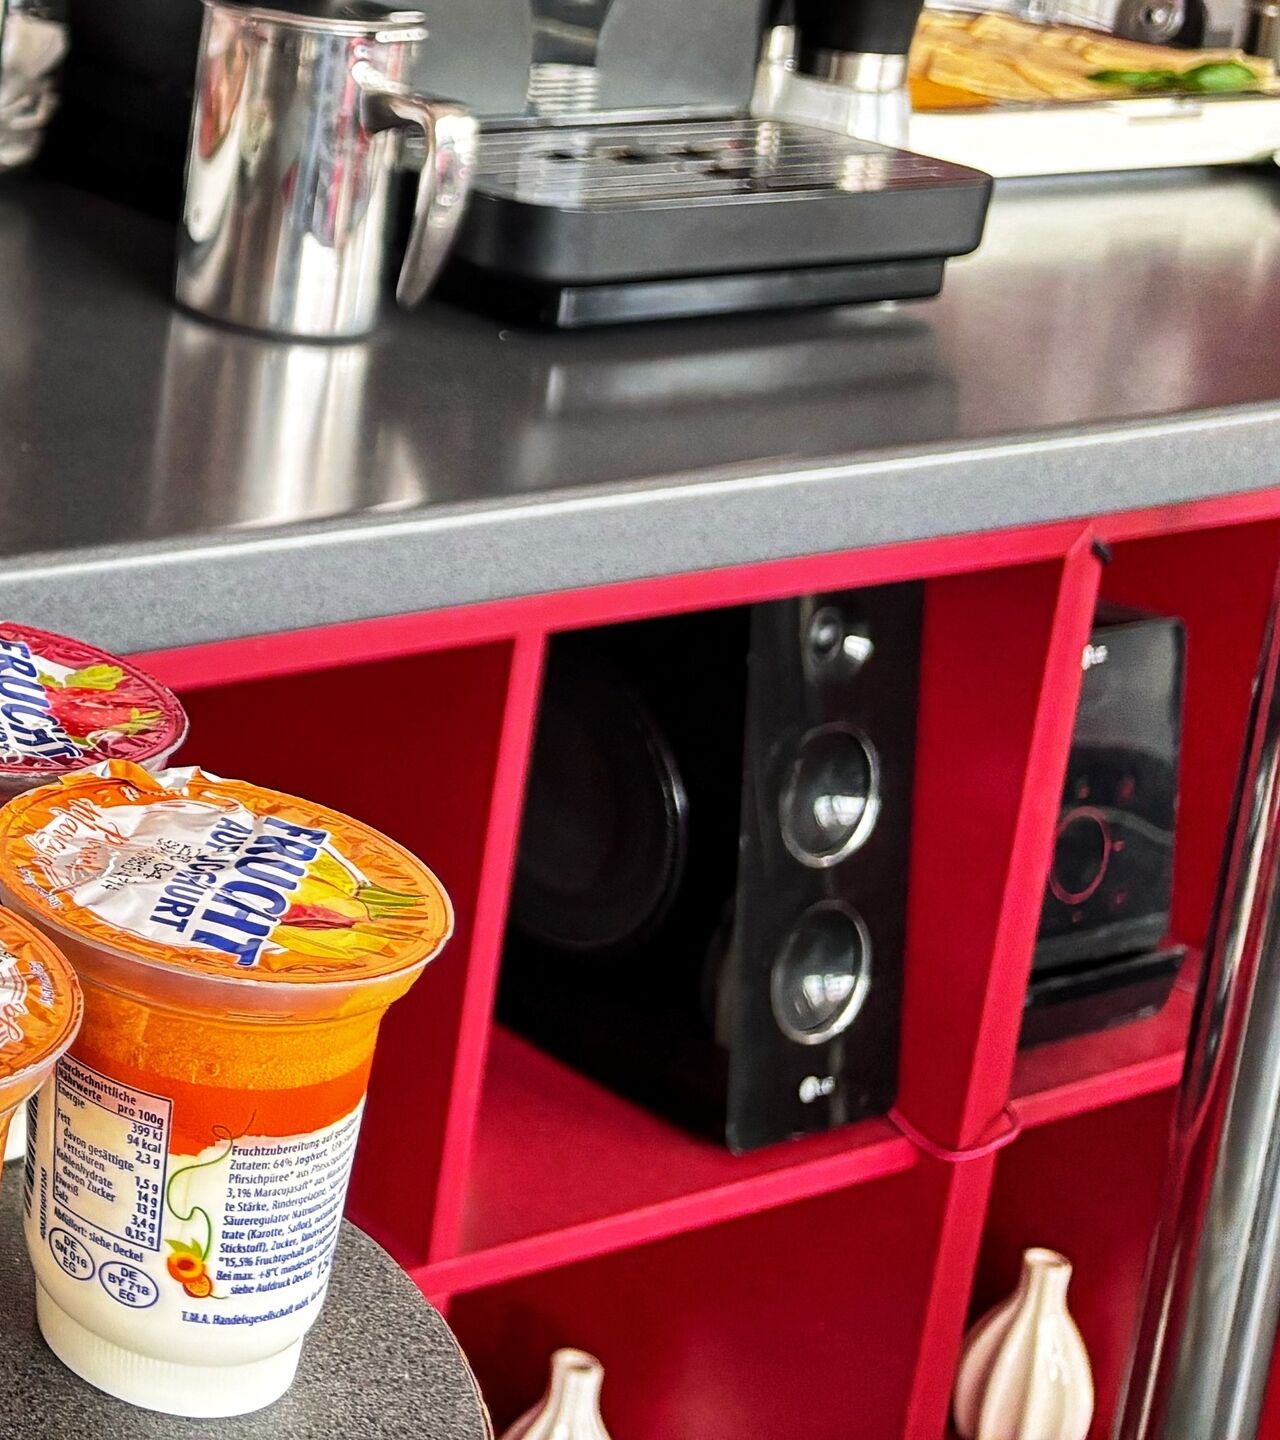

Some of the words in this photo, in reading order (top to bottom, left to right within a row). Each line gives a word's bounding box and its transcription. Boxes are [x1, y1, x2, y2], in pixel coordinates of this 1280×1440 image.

[191, 816, 329, 966] FRUCHT
[58, 1059, 137, 1106] Durchschnittliche
[57, 1080, 85, 1109] Energie
[58, 1070, 102, 1102] Nährwerte
[118, 1102, 135, 1117] pro
[139, 1109, 164, 1128] 100g
[56, 1108, 71, 1126] Fett
[131, 1123, 150, 1137] 399
[63, 1127, 87, 1149] davon
[88, 1142, 135, 1173] gesättigte
[127, 1134, 139, 1146] 94
[142, 1137, 161, 1153] kcal
[232, 1140, 320, 1156] Fruchtzubereitung
[63, 1138, 105, 1172] Fettsäuren
[56, 1147, 113, 1189] Kohlenhydrate
[230, 1160, 271, 1171] Zutaten:
[55, 1171, 79, 1196] Eiweiß
[63, 1165, 86, 1187] davon
[87, 1180, 116, 1203] Zucker
[55, 1187, 69, 1205] Salz
[226, 1188, 252, 1199] 3,1%
[238, 1201, 269, 1212] Stärke,
[223, 1213, 289, 1229] Säureregulator
[63, 1235, 78, 1252] DE
[222, 1230, 245, 1239] trate
[247, 1228, 284, 1241] (Karotte,
[89, 1231, 111, 1251] siehe
[114, 1243, 143, 1262] Deckel
[220, 1242, 268, 1253] Stickstoff),
[62, 1258, 76, 1274] EG
[120, 1266, 137, 1281] DE
[108, 1272, 122, 1287] BY
[128, 1280, 150, 1296] 718
[231, 1284, 254, 1295] siehe
[256, 1277, 290, 1293] Aufdruck
[119, 1289, 137, 1303] EG
